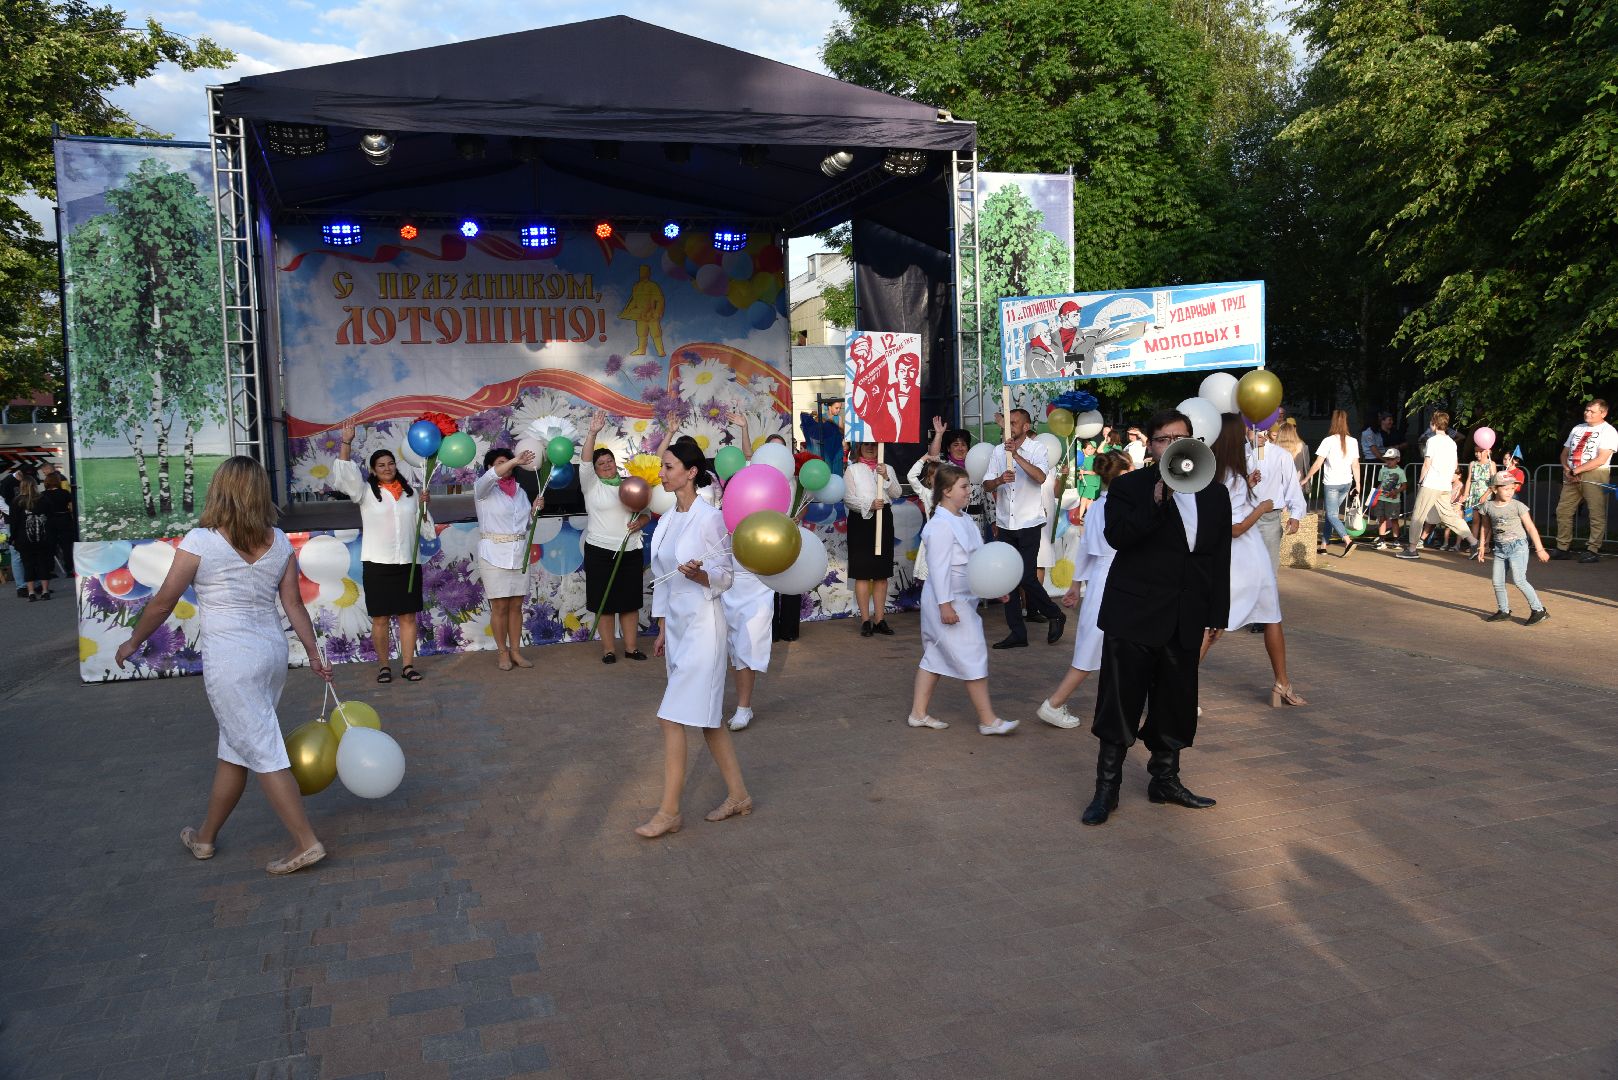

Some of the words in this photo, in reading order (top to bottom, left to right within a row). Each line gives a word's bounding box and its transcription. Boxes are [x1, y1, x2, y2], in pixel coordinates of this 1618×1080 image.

[332, 271, 354, 300] С
[376, 272, 604, 303] ПРАЗДНИКОМ,
[1169, 299, 1217, 323] УДАРНЫЙ
[1221, 294, 1247, 312] ТРУД
[334, 305, 608, 345] ЛОТОШИНО!
[1143, 326, 1229, 354] МОЛОДЫХ
